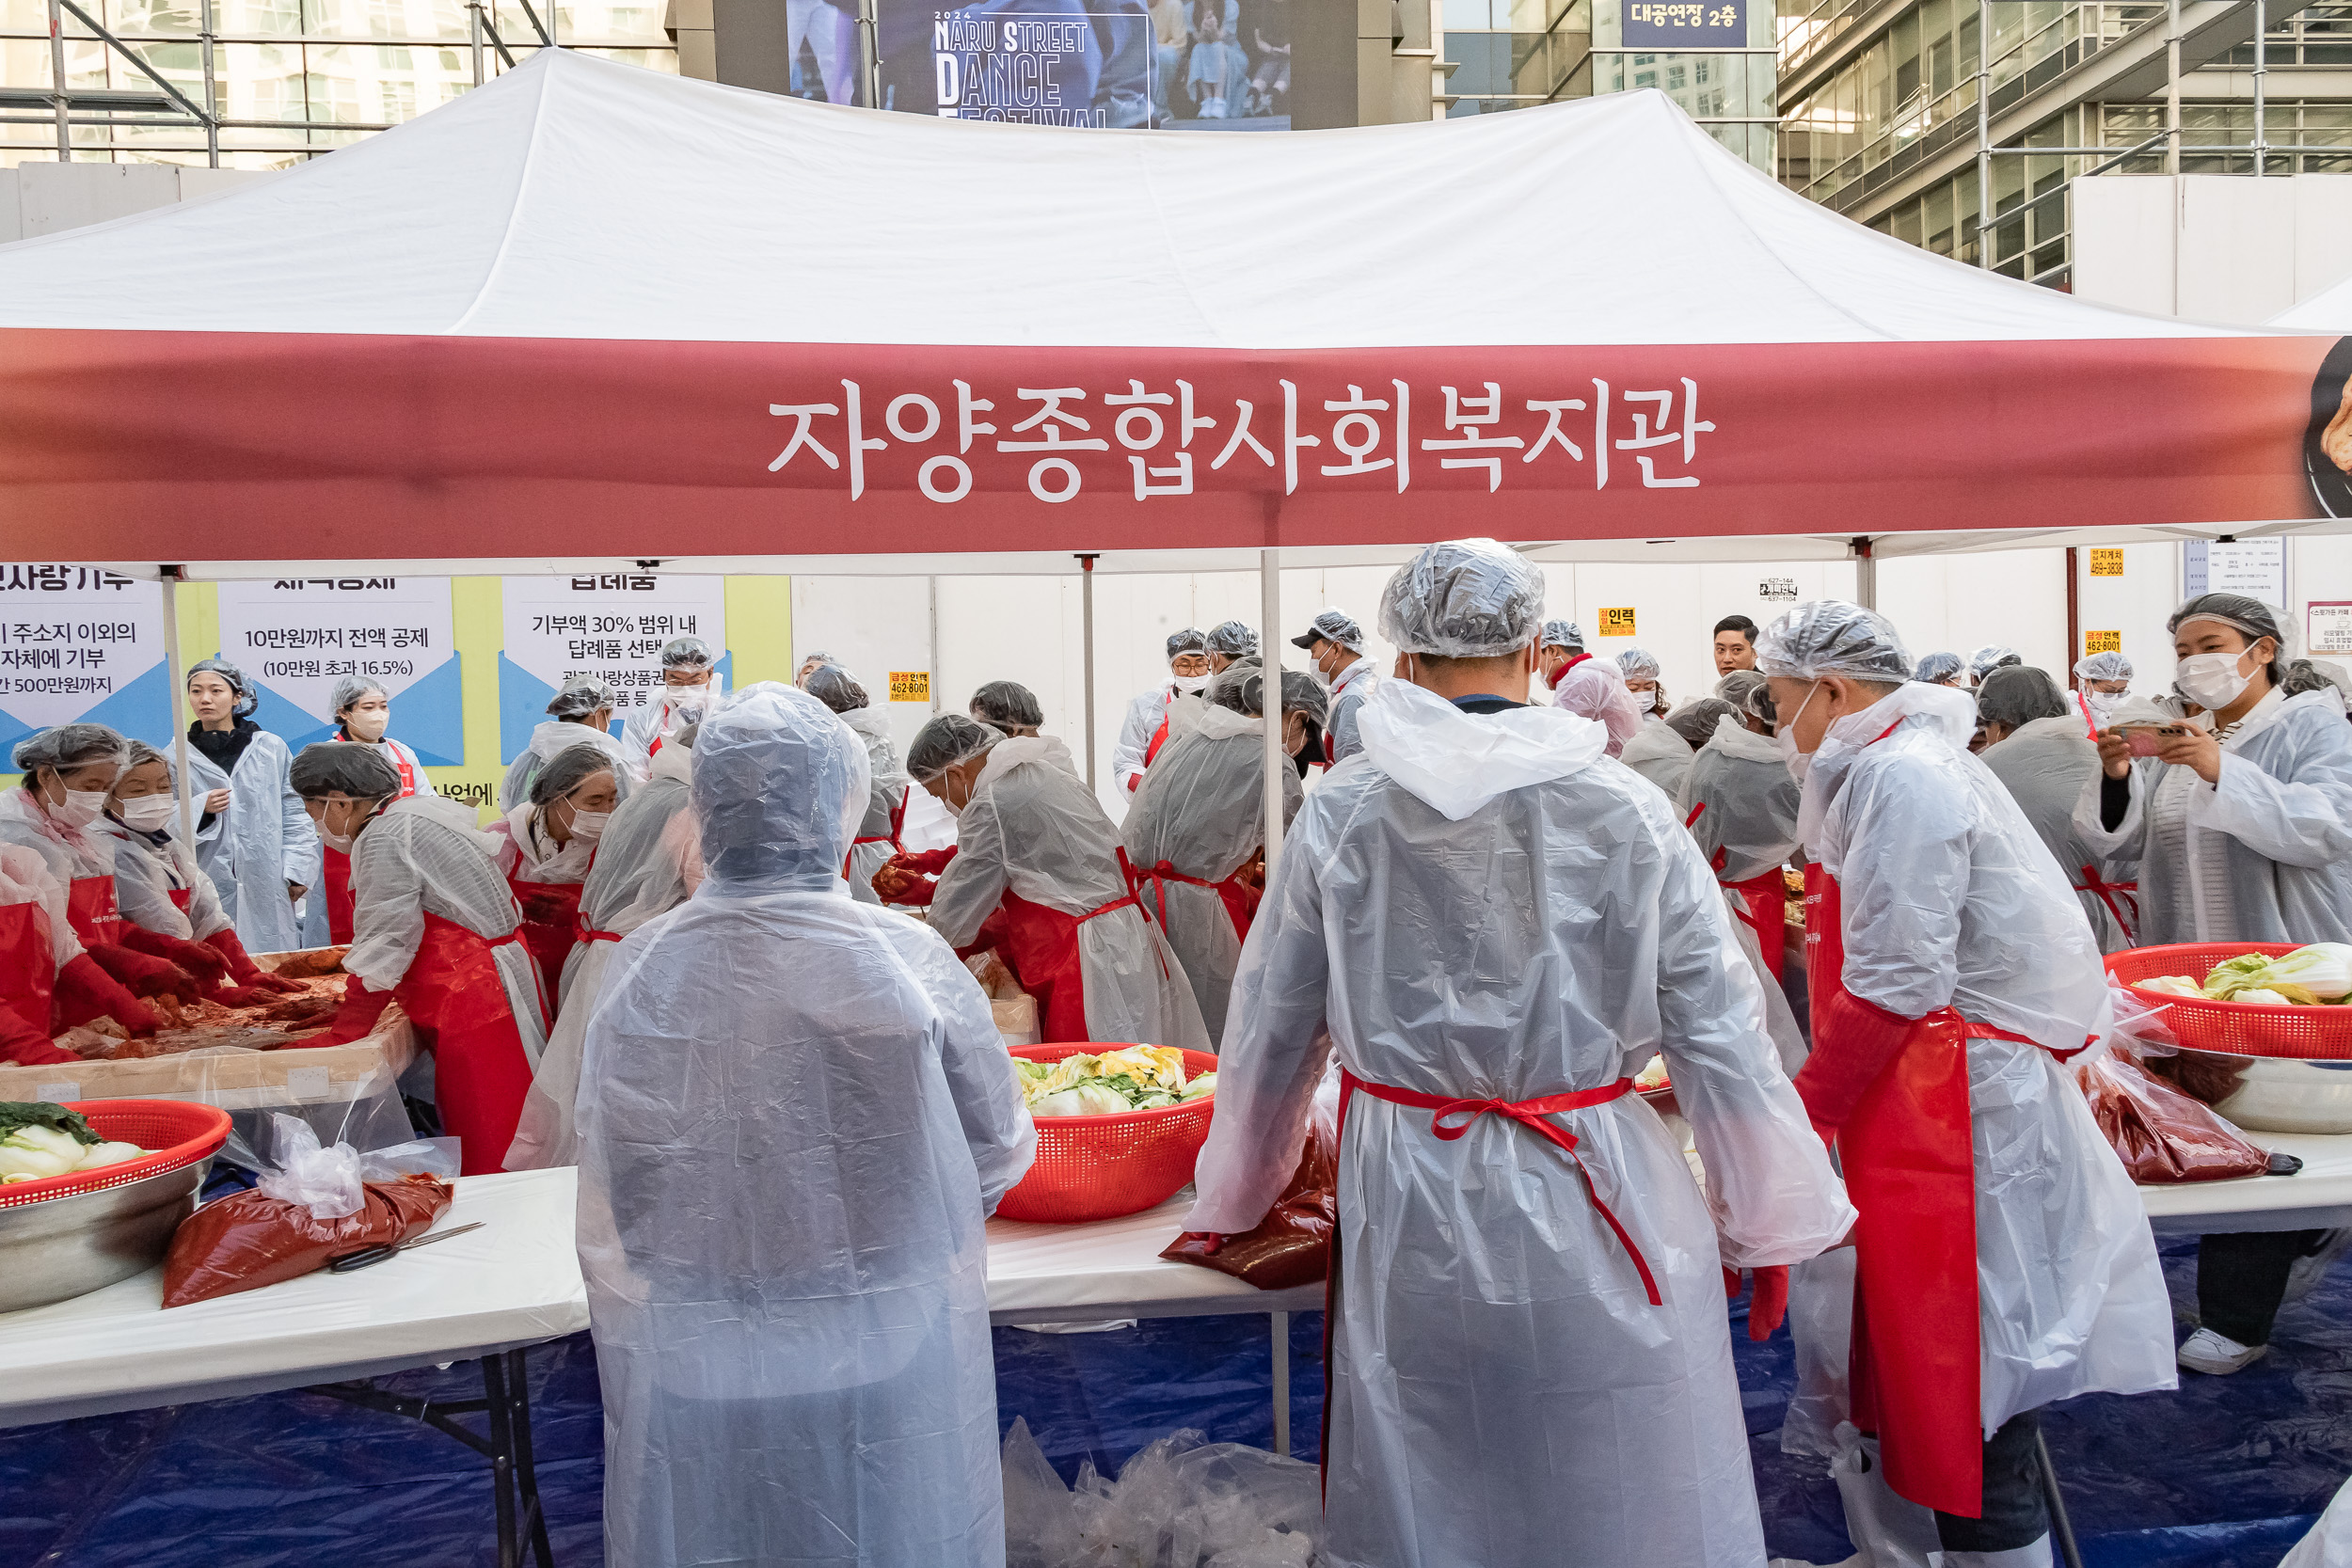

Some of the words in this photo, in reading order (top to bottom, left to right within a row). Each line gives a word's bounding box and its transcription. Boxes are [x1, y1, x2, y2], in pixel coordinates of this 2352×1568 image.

[934, 11, 972, 20] 2024
[1631, 4, 1705, 27] 대공연장
[1708, 4, 1738, 28] 2층
[935, 21, 996, 52] NARU
[1004, 22, 1088, 53] STREET
[936, 53, 1062, 107] DANCE
[767, 377, 1717, 503] 자양종합사회복지관
[2099, 550, 2122, 560] 지게차
[2090, 562, 2123, 574] 469-3838
[532, 615, 587, 635] 기부액
[592, 616, 634, 633] 30%
[639, 615, 674, 634] 범위
[679, 615, 696, 634] 내
[1609, 609, 1634, 625] 인력
[13, 623, 72, 643] 주소지
[78, 623, 135, 643] 이외의
[245, 627, 343, 648] 10만원까지
[349, 627, 386, 648] 전액
[391, 627, 429, 648] 공제
[568, 640, 622, 659] 답례품
[2087, 641, 2119, 651] 462-8001
[2, 648, 60, 669] 자체에
[67, 648, 105, 669] 기부
[263, 660, 320, 677] (10만원
[325, 660, 357, 676] 초과
[361, 658, 413, 676] 16.5%)
[14, 676, 112, 694] 500만원까지
[891, 683, 928, 693] 462-8001
